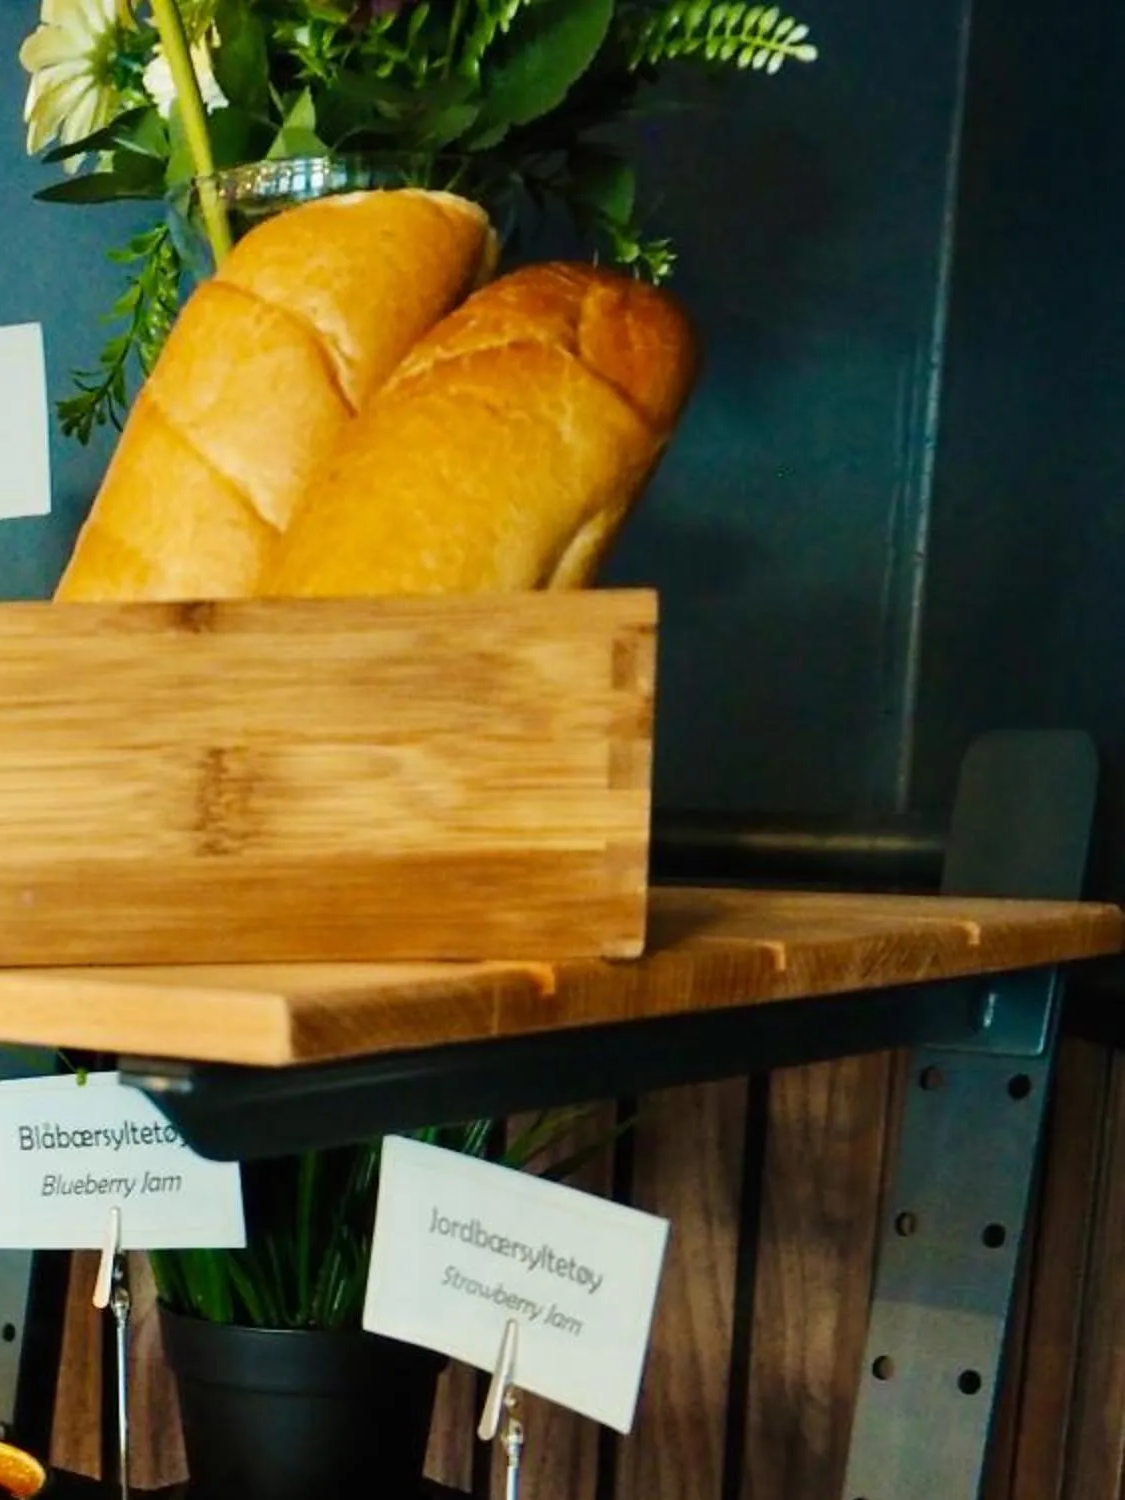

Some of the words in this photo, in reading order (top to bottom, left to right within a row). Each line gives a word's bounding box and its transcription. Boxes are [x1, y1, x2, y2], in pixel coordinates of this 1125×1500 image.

[41, 1173, 136, 1198] Blueberry
[140, 1170, 182, 1194] Jam
[429, 1204, 604, 1295] Jordbærsyltetøy
[440, 1263, 545, 1322] Strawberry
[543, 1303, 585, 1337] Jam
